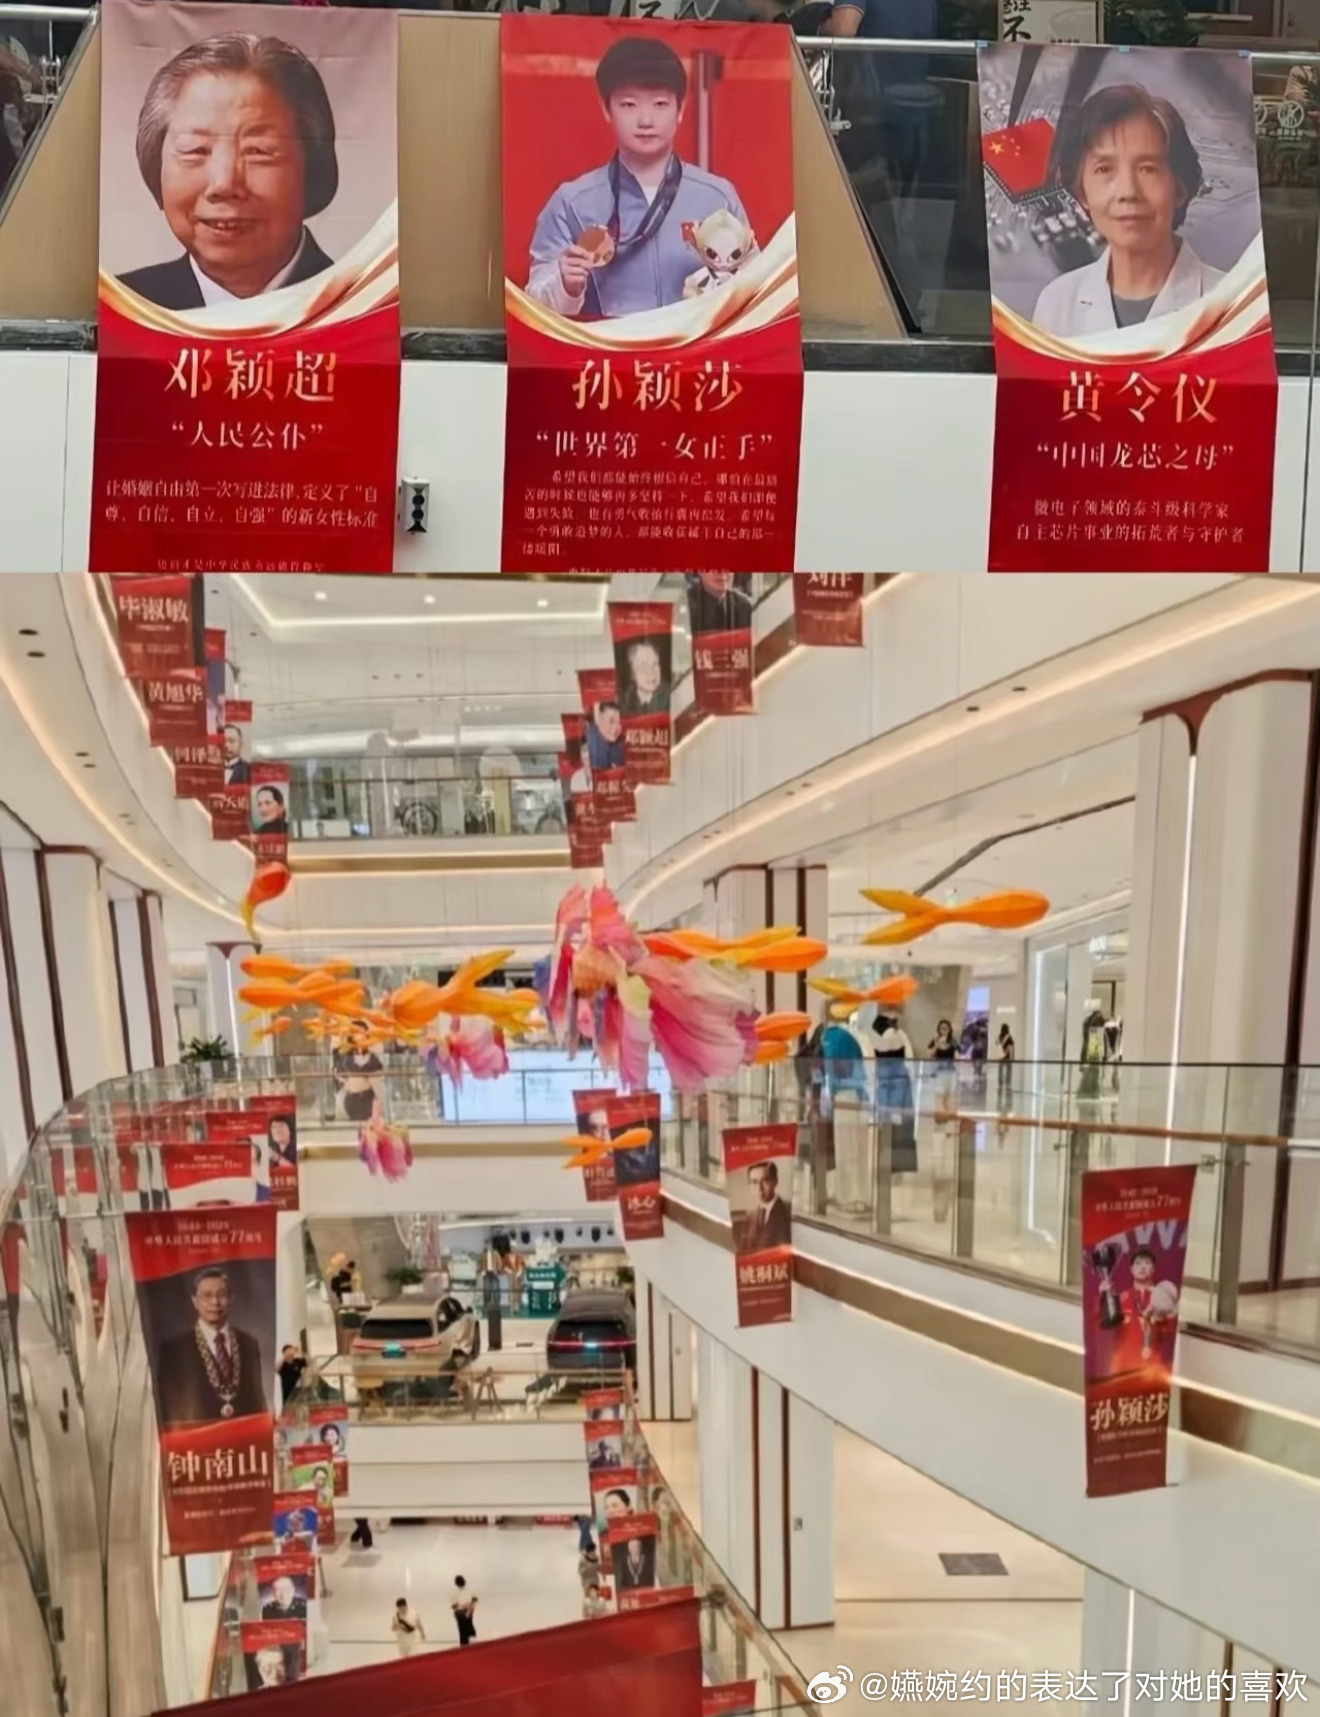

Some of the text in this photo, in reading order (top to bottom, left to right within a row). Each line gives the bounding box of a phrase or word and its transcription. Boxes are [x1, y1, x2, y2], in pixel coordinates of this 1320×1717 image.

[164, 348, 337, 402] 邓颖超
[572, 358, 744, 412] 孙颖莎
[1059, 371, 1218, 424] 黄令仪
[1017, 523, 1245, 543] 自主芯片事业的拓荒者与守护者
[119, 594, 189, 623] 毕淑敏
[149, 681, 204, 704] 黄旭华
[1090, 1393, 1170, 1432] 孙颖莎
[168, 1444, 269, 1482] 钟南山
